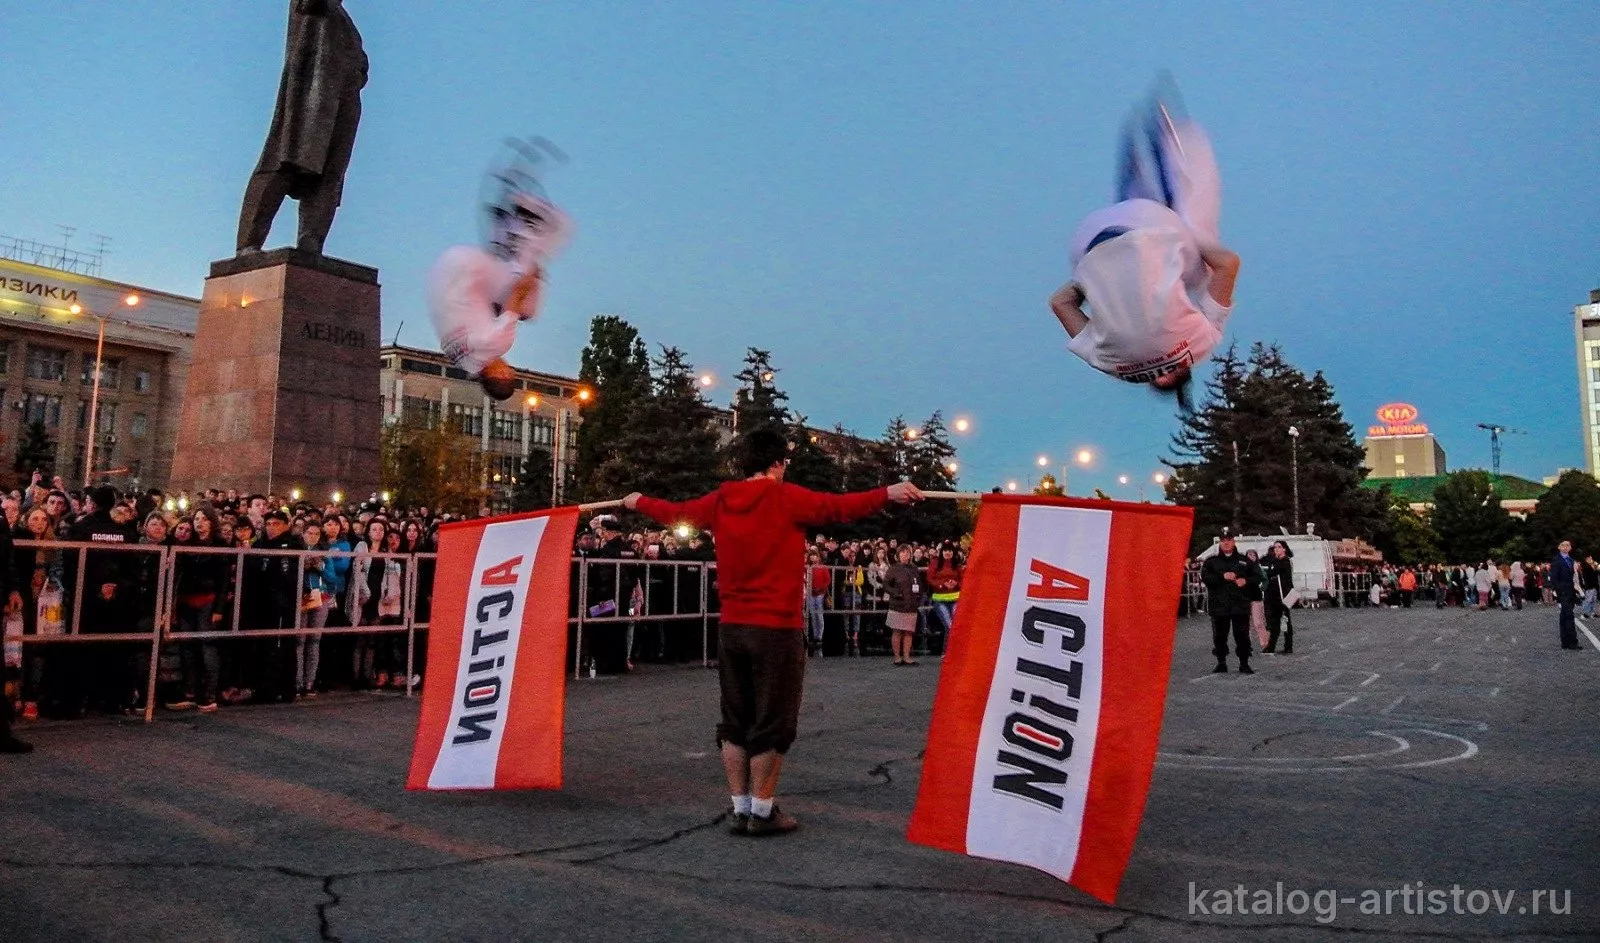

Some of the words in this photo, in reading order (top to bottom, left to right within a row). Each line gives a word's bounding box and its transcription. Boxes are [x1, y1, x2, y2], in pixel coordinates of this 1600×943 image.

[1384, 408, 1411, 420] KIA
[1368, 426, 1386, 436] KIA
[1388, 423, 1429, 435] MOTORS
